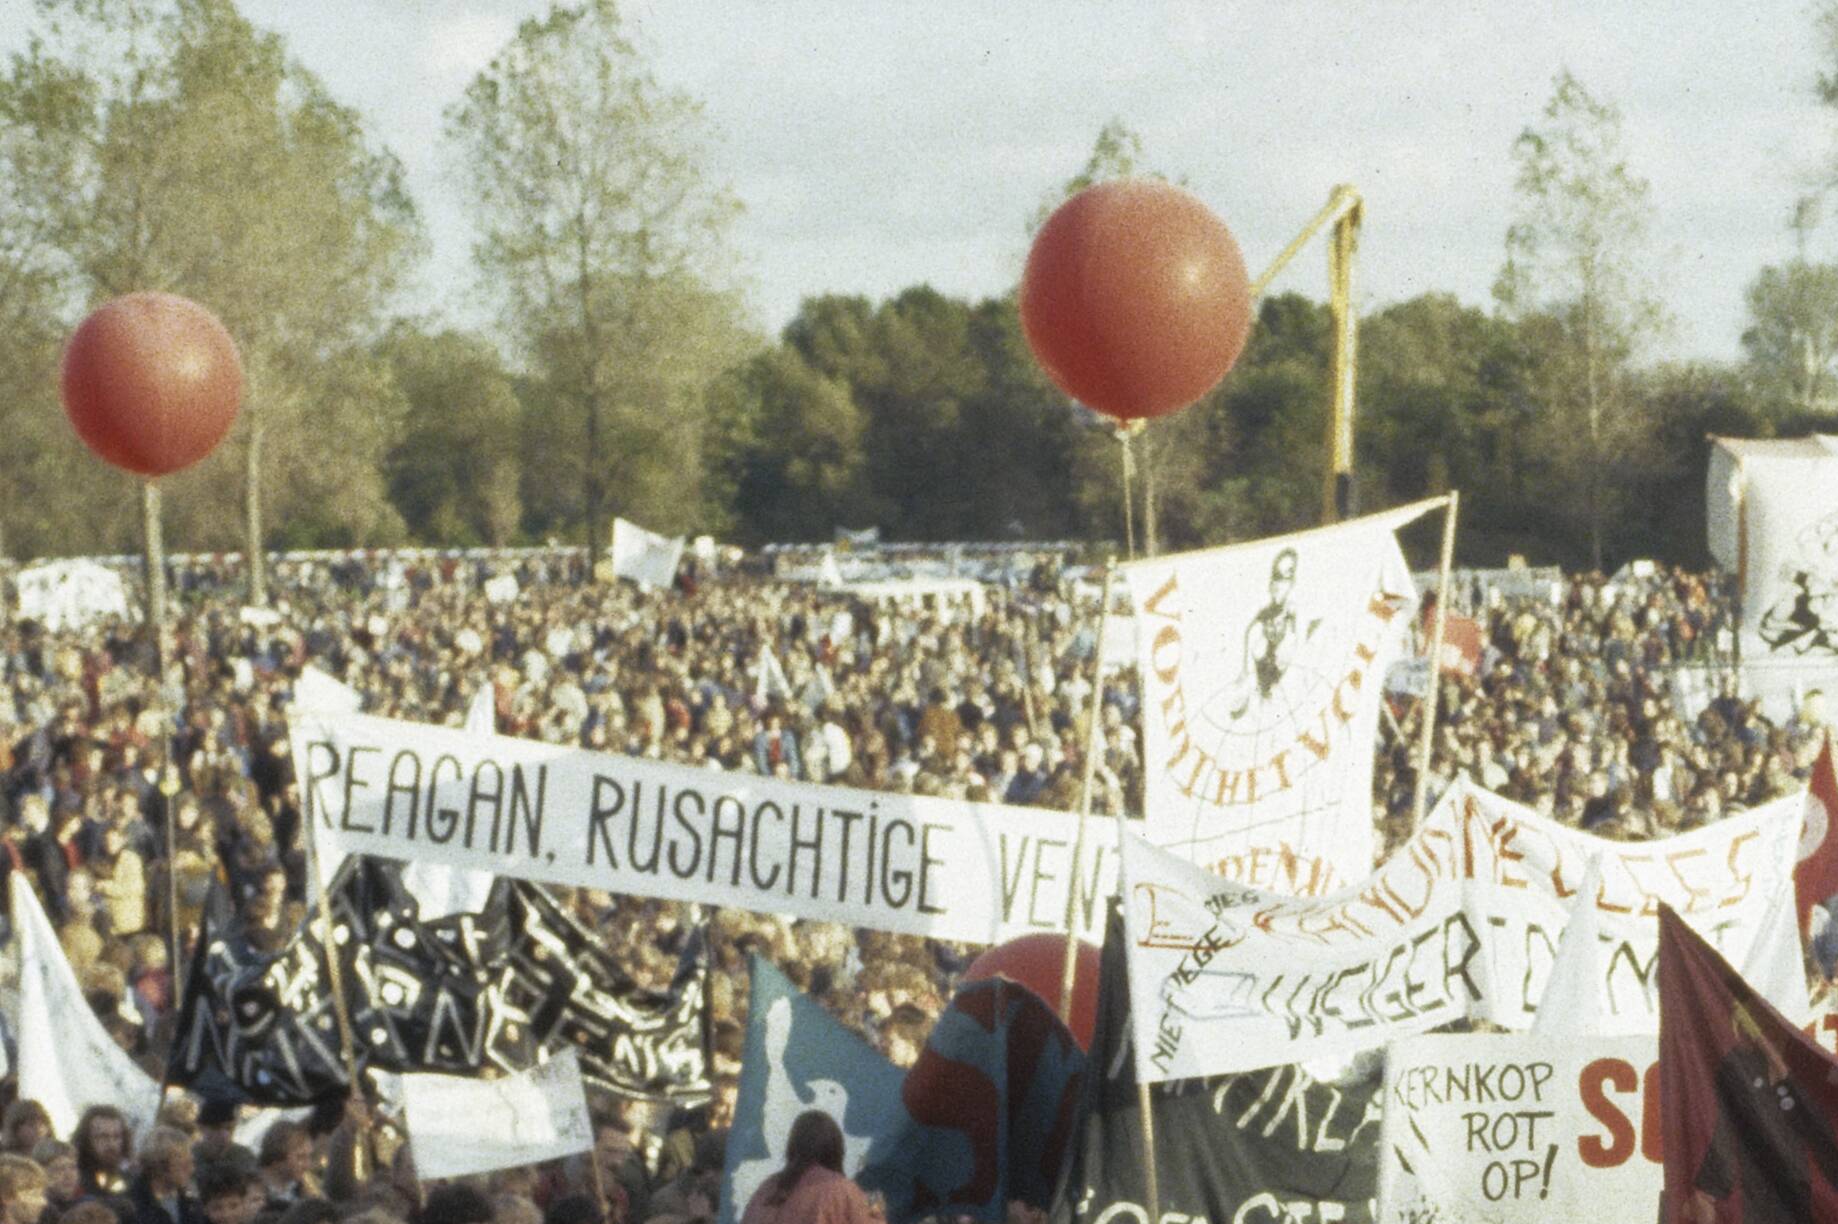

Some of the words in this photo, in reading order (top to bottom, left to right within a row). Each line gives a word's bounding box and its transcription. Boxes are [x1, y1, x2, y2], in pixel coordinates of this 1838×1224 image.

[1001, 831, 1121, 932] VEN
[1393, 1061, 1554, 1112] KERNKOP
[1461, 1111, 1556, 1153] ROT
[1482, 1143, 1559, 1201] OP!
